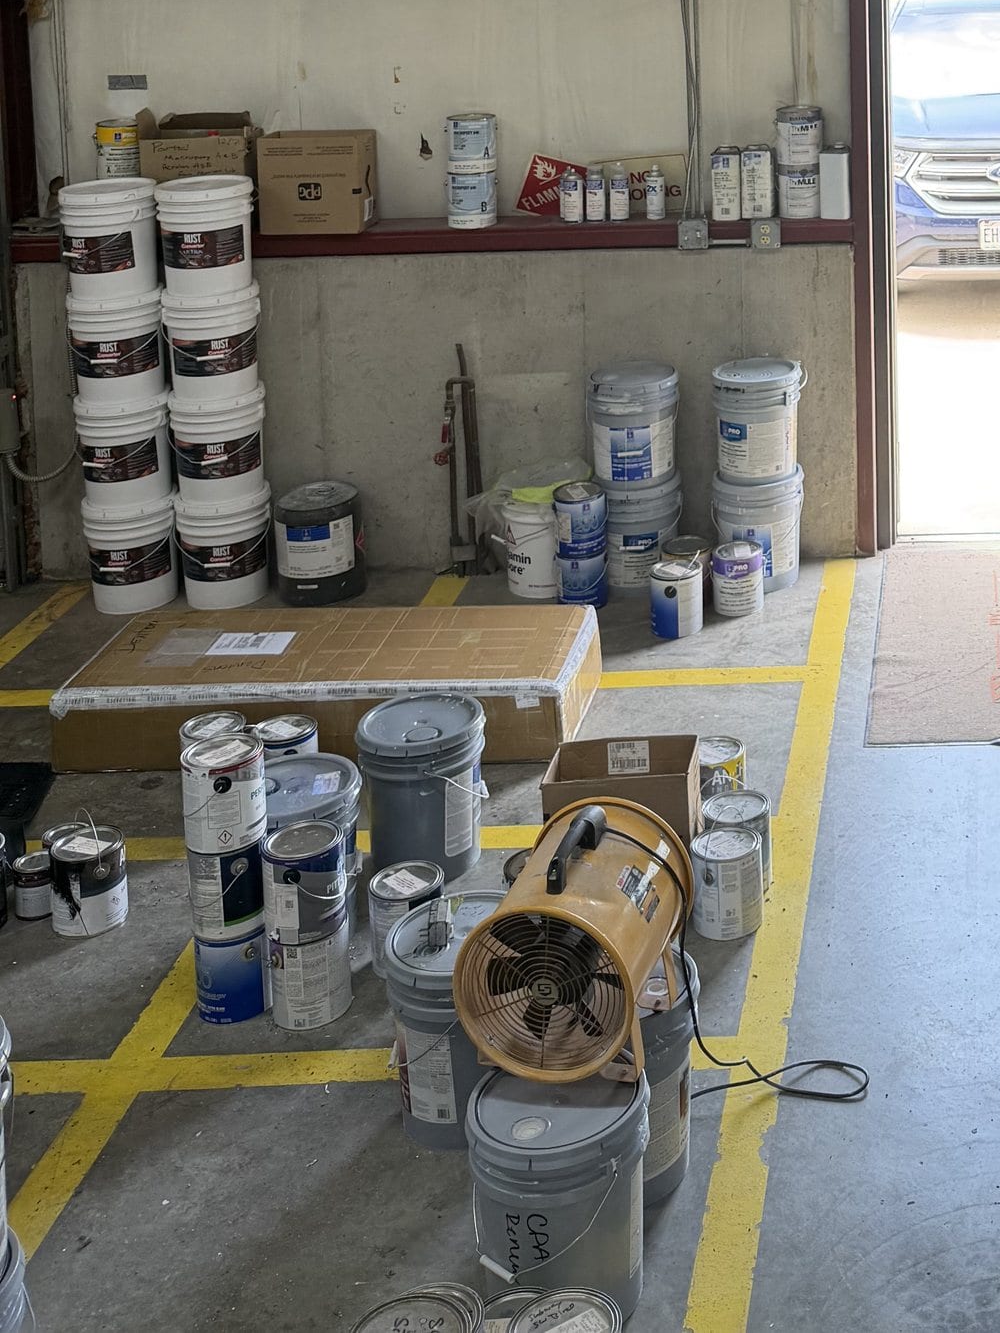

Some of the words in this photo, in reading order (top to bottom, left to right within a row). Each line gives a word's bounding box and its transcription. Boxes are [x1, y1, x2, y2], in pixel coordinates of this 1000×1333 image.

[483, 146, 490, 158] A
[298, 183, 322, 201] PPG
[480, 201, 488, 212] B
[183, 233, 202, 243] RUST
[99, 341, 119, 353] RUST
[210, 339, 229, 350] RUST
[95, 447, 111, 458] RUST
[206, 443, 225, 454] RUST
[110, 551, 129, 562] RUST
[212, 546, 231, 557] RUST
[733, 563, 749, 572] PRO
